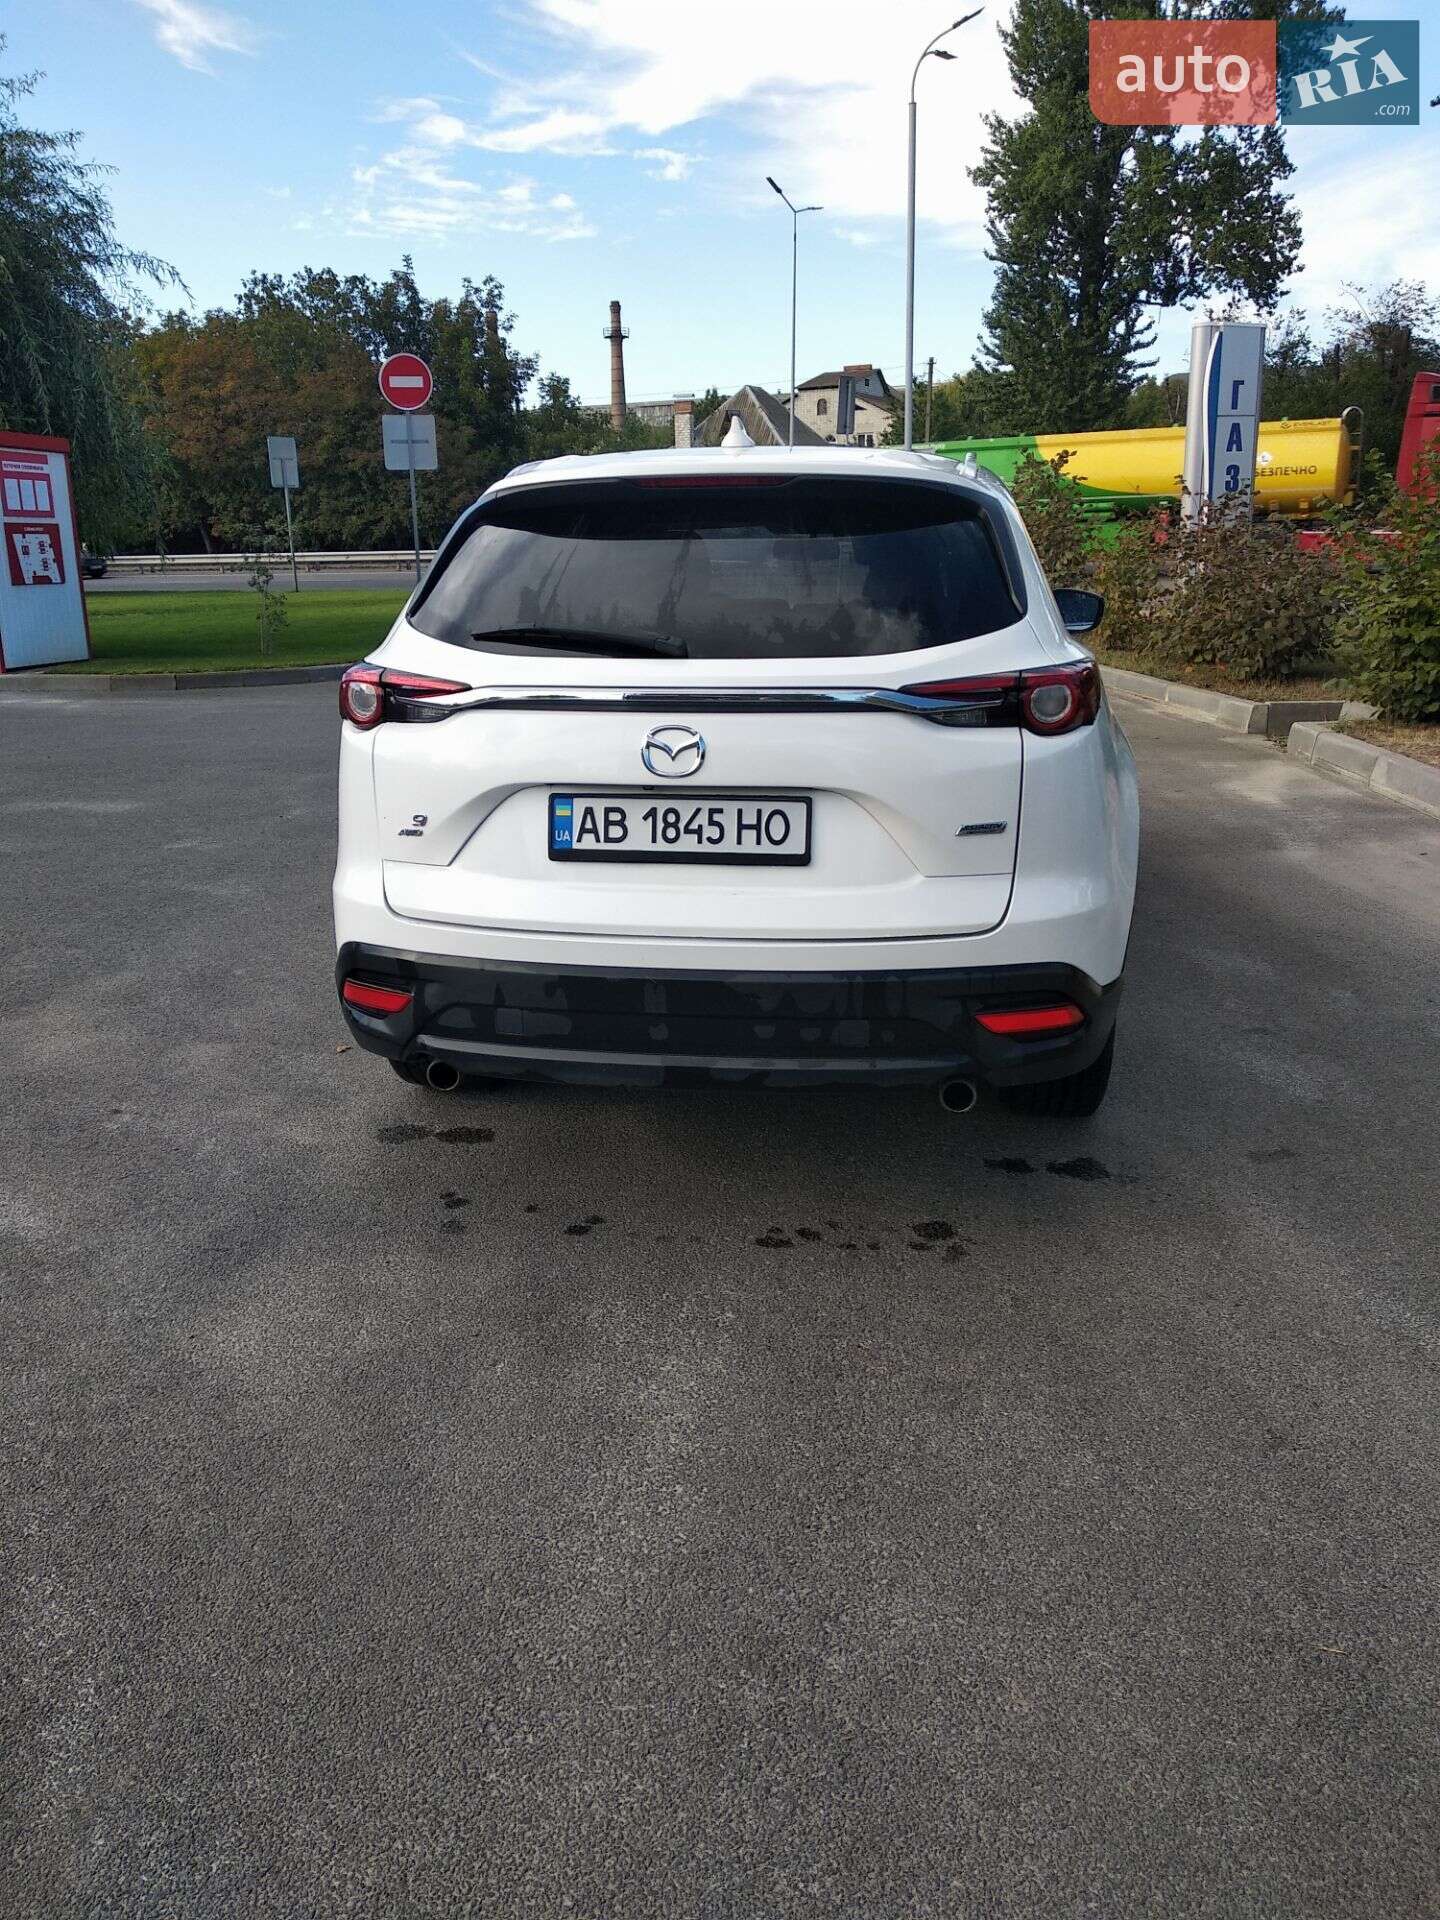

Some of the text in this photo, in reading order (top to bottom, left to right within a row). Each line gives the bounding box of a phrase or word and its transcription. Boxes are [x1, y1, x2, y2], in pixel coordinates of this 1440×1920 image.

[1225, 379, 1245, 493] ГАЗ
[555, 829, 571, 842] UA
[576, 806, 790, 846] AB 1845 HO
